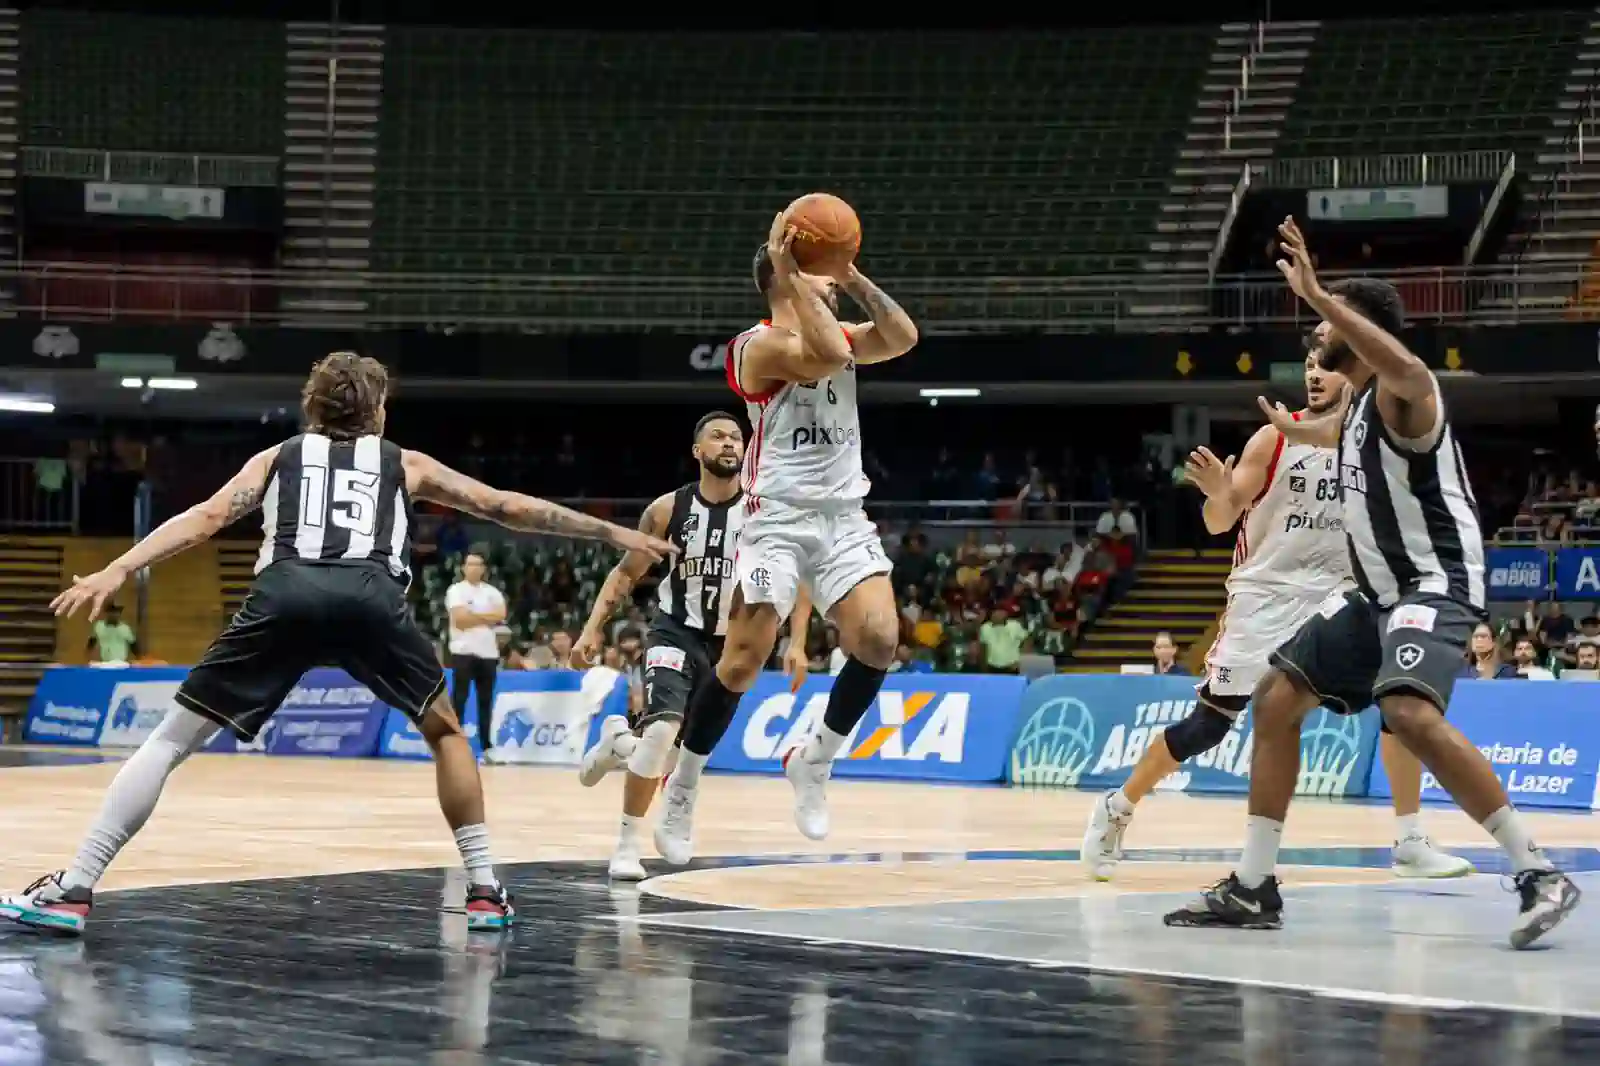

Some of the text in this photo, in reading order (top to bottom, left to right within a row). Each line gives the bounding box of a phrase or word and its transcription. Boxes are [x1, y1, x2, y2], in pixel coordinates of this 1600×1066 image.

[827, 380, 837, 405] 6
[300, 464, 379, 537] 15
[1315, 478, 1339, 501] 83
[679, 556, 733, 581] BOTAFO
[703, 585, 720, 611] 7
[1547, 743, 1578, 766] de
[1507, 769, 1574, 794] Lazer
